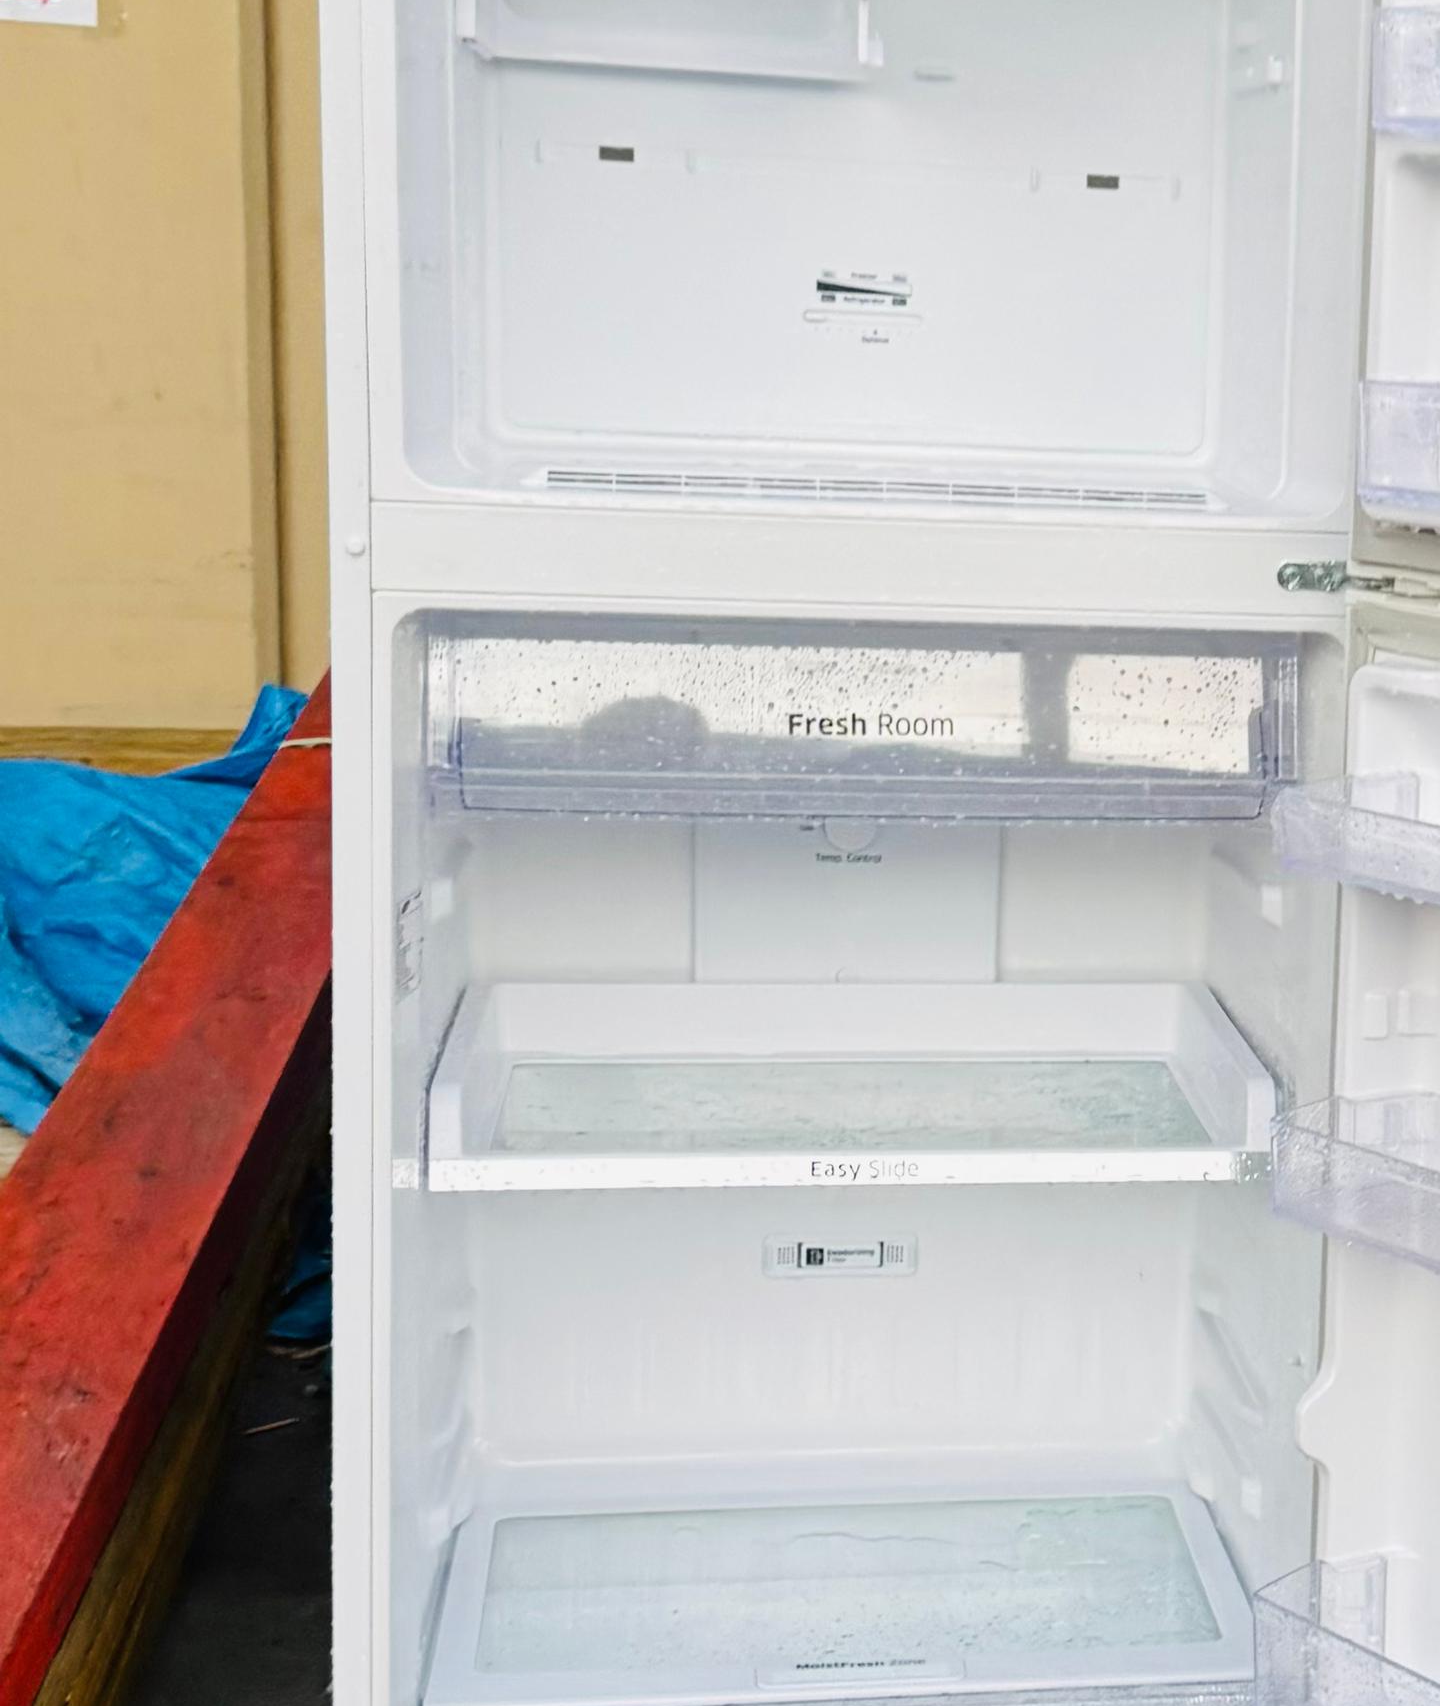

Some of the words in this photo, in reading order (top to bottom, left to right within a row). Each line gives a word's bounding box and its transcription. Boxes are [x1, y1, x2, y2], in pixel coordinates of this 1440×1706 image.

[788, 712, 867, 736] Fresh
[878, 713, 955, 736] Room
[846, 852, 882, 863] Control
[811, 1161, 861, 1181] Easy
[868, 1159, 920, 1179] Slide
[889, 1658, 926, 1667] Zone
